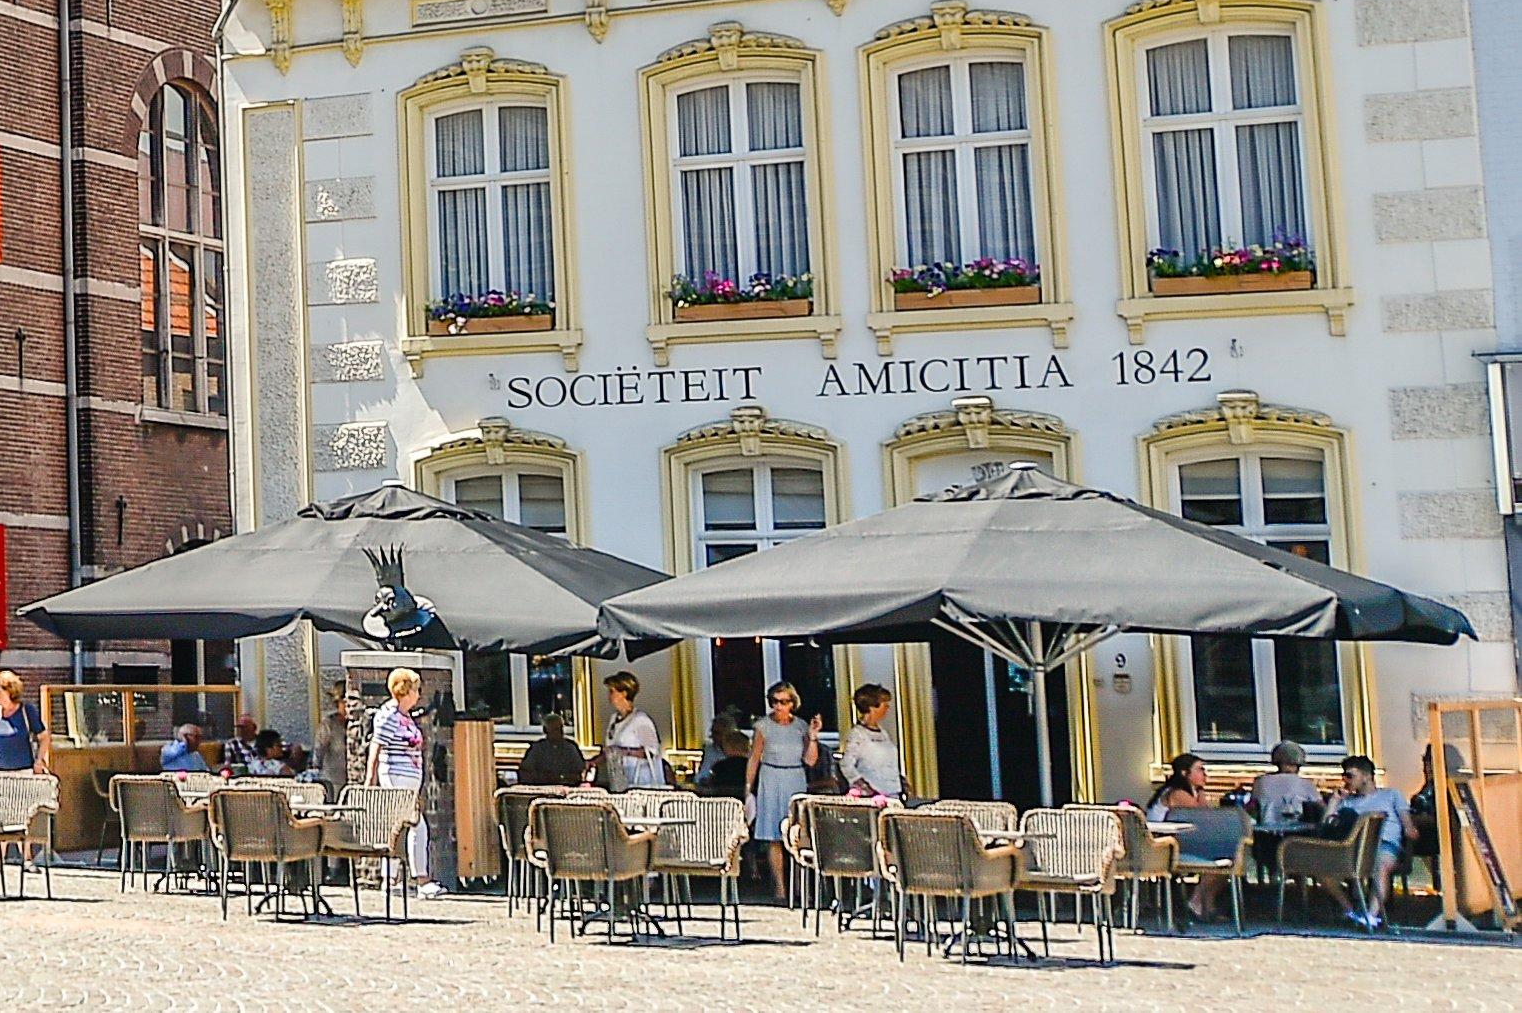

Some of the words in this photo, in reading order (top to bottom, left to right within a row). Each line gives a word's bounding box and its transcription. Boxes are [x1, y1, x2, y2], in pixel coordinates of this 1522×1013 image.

[508, 365, 762, 409] SOCIËTEIT
[816, 354, 1074, 397] AMICITIA
[1111, 347, 1212, 386] 1842
[1115, 652, 1127, 669] 9
